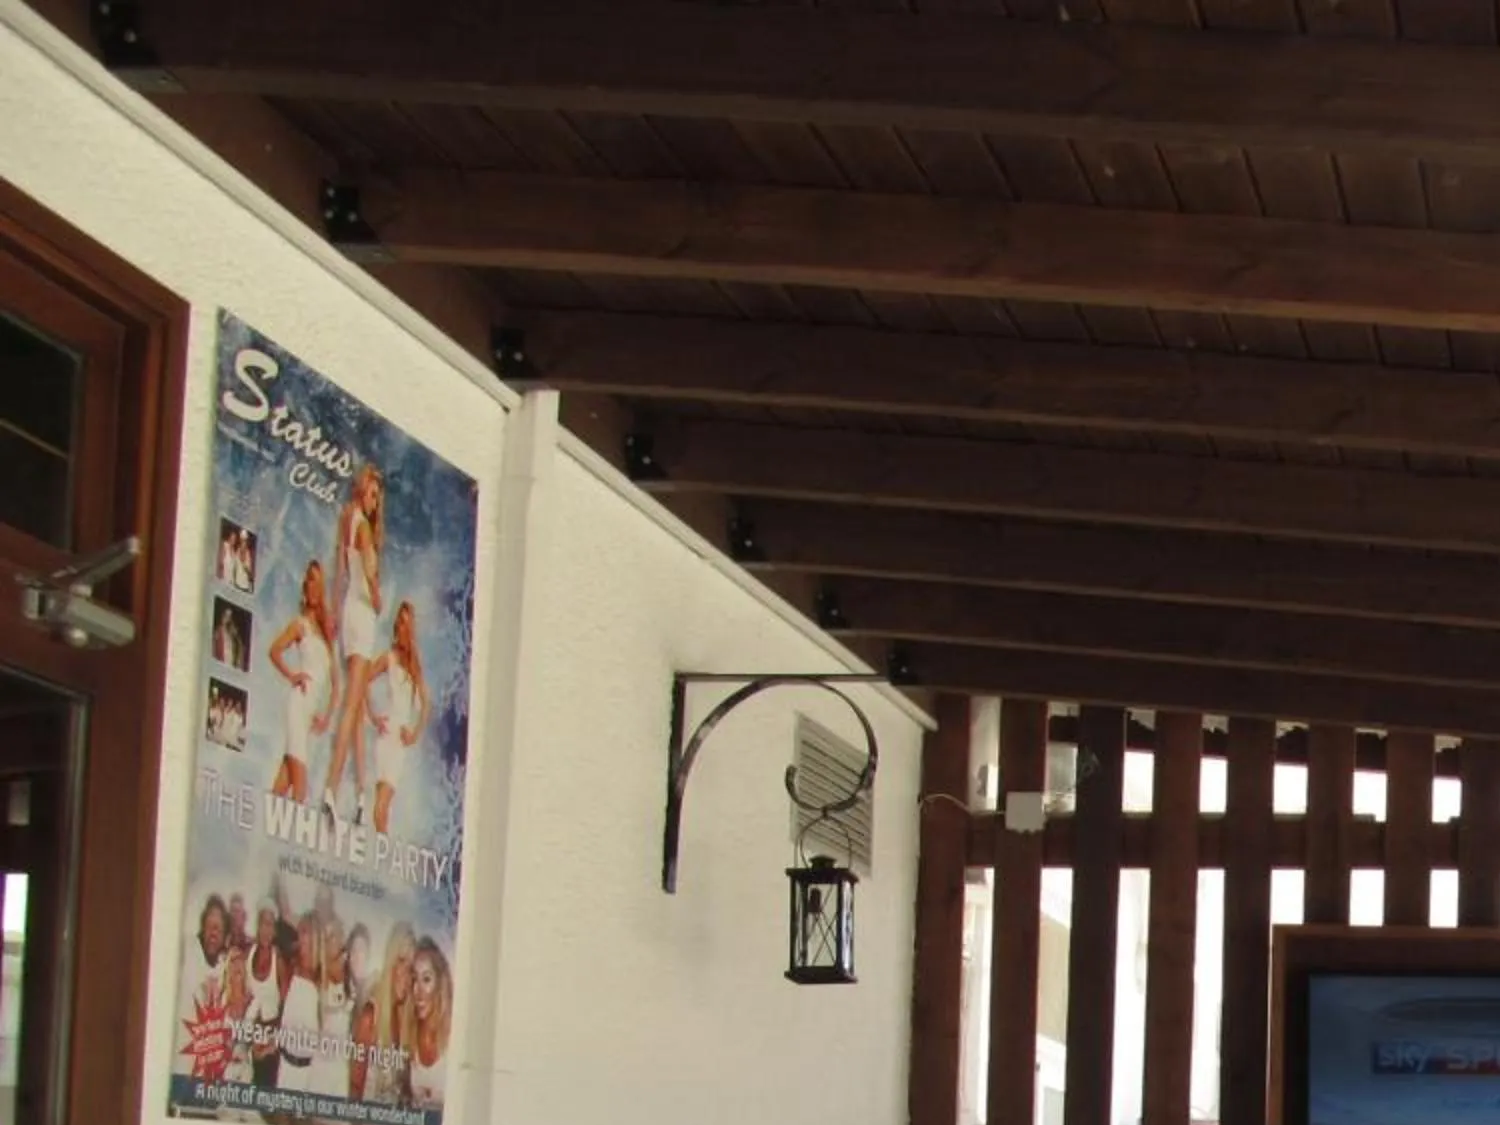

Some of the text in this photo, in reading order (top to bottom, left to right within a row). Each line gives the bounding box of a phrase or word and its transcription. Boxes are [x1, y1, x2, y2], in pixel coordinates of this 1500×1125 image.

[223, 349, 353, 477] Status
[289, 463, 338, 503] Club
[201, 767, 256, 831] THE
[265, 792, 368, 865] WHITE
[374, 831, 449, 892] PARTY
[1378, 1044, 1429, 1072] sky
[194, 1083, 205, 1099] A
[207, 1079, 241, 1107] night
[241, 1085, 257, 1105] of
